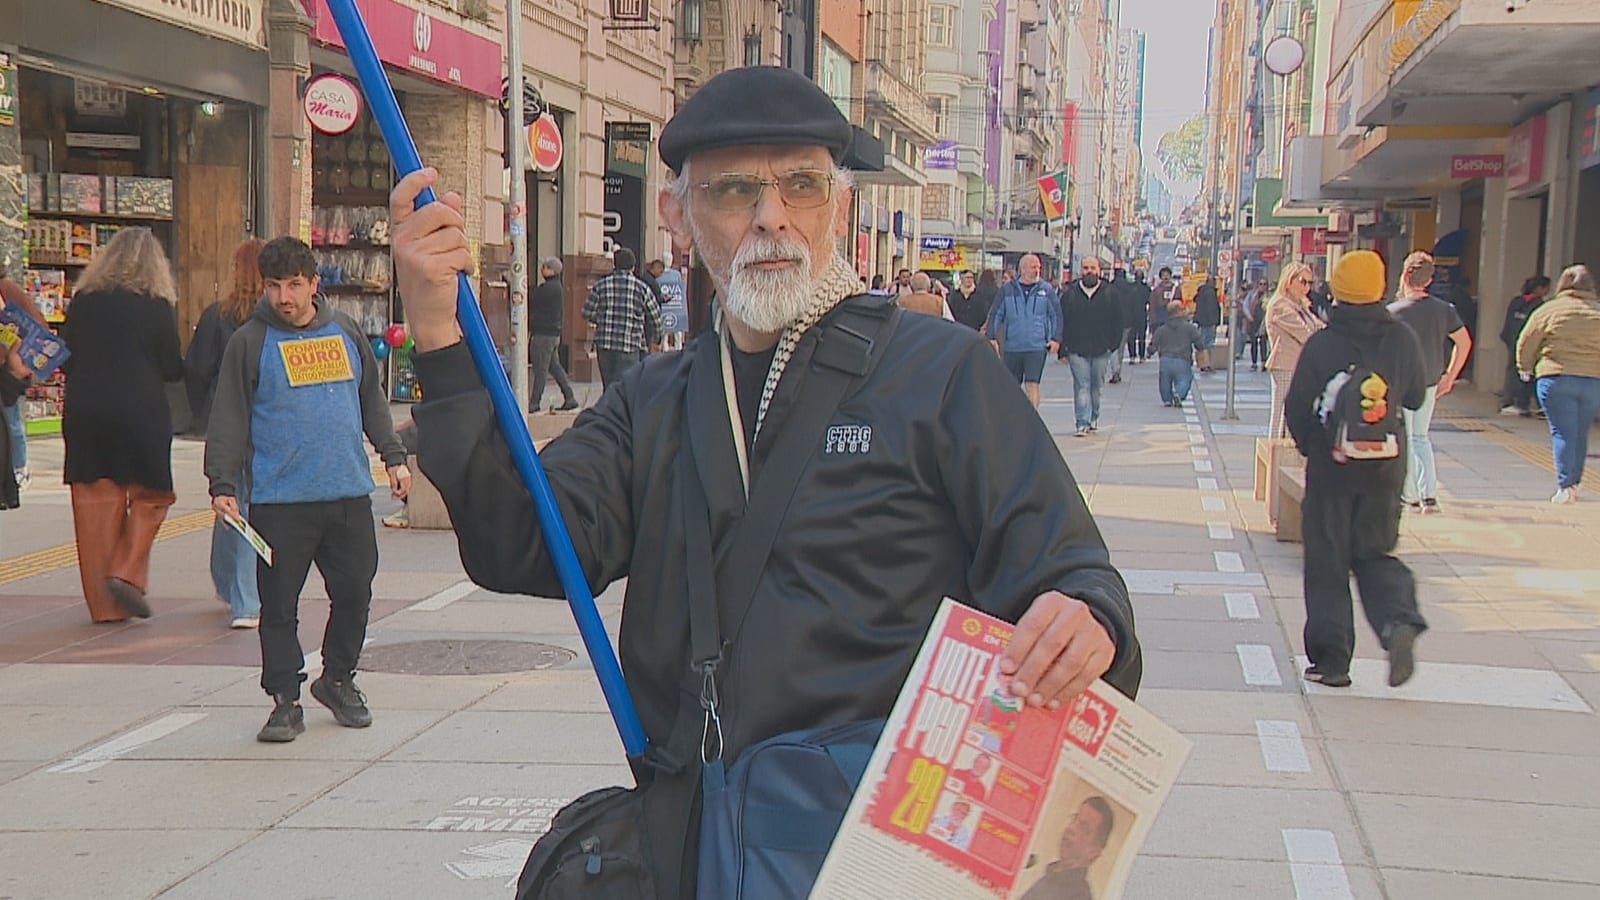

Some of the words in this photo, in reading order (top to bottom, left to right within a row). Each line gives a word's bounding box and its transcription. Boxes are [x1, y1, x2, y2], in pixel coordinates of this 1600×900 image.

[310, 89, 346, 104] CASA
[309, 101, 352, 120] Maria
[1453, 158, 1502, 174] BelShop
[286, 339, 339, 354] COMPRO
[288, 348, 342, 367] OURO
[826, 425, 872, 444] CTRG
[928, 635, 993, 704] VOTE
[890, 757, 946, 834] 29
